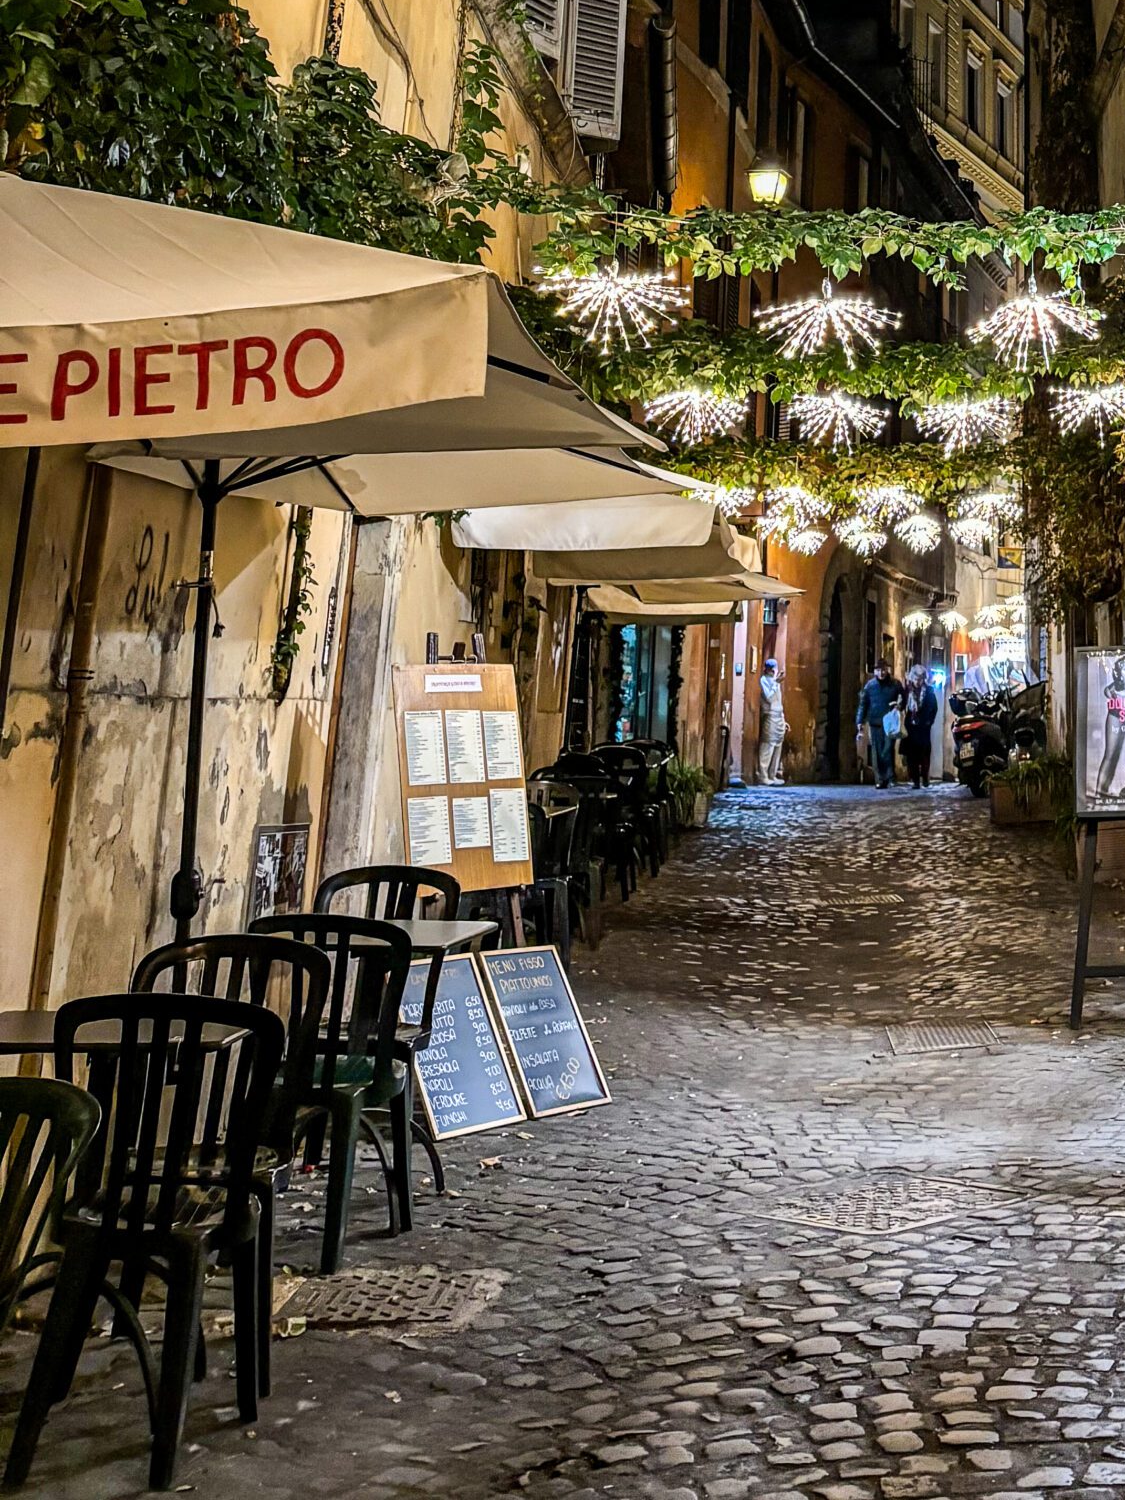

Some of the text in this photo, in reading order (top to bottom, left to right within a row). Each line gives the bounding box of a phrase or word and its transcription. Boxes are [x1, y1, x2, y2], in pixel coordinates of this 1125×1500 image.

[50, 328, 345, 421] PIETRO
[488, 956, 545, 976] MENU FISSO
[520, 1048, 560, 1069] INSALATA
[420, 1059, 460, 1079] BRESAOLA
[424, 1078, 454, 1093] NAPOLI
[527, 1074, 555, 1092] ACQUA
[429, 1092, 469, 1110] VERDURE
[434, 1110, 468, 1129] FUNGHI
